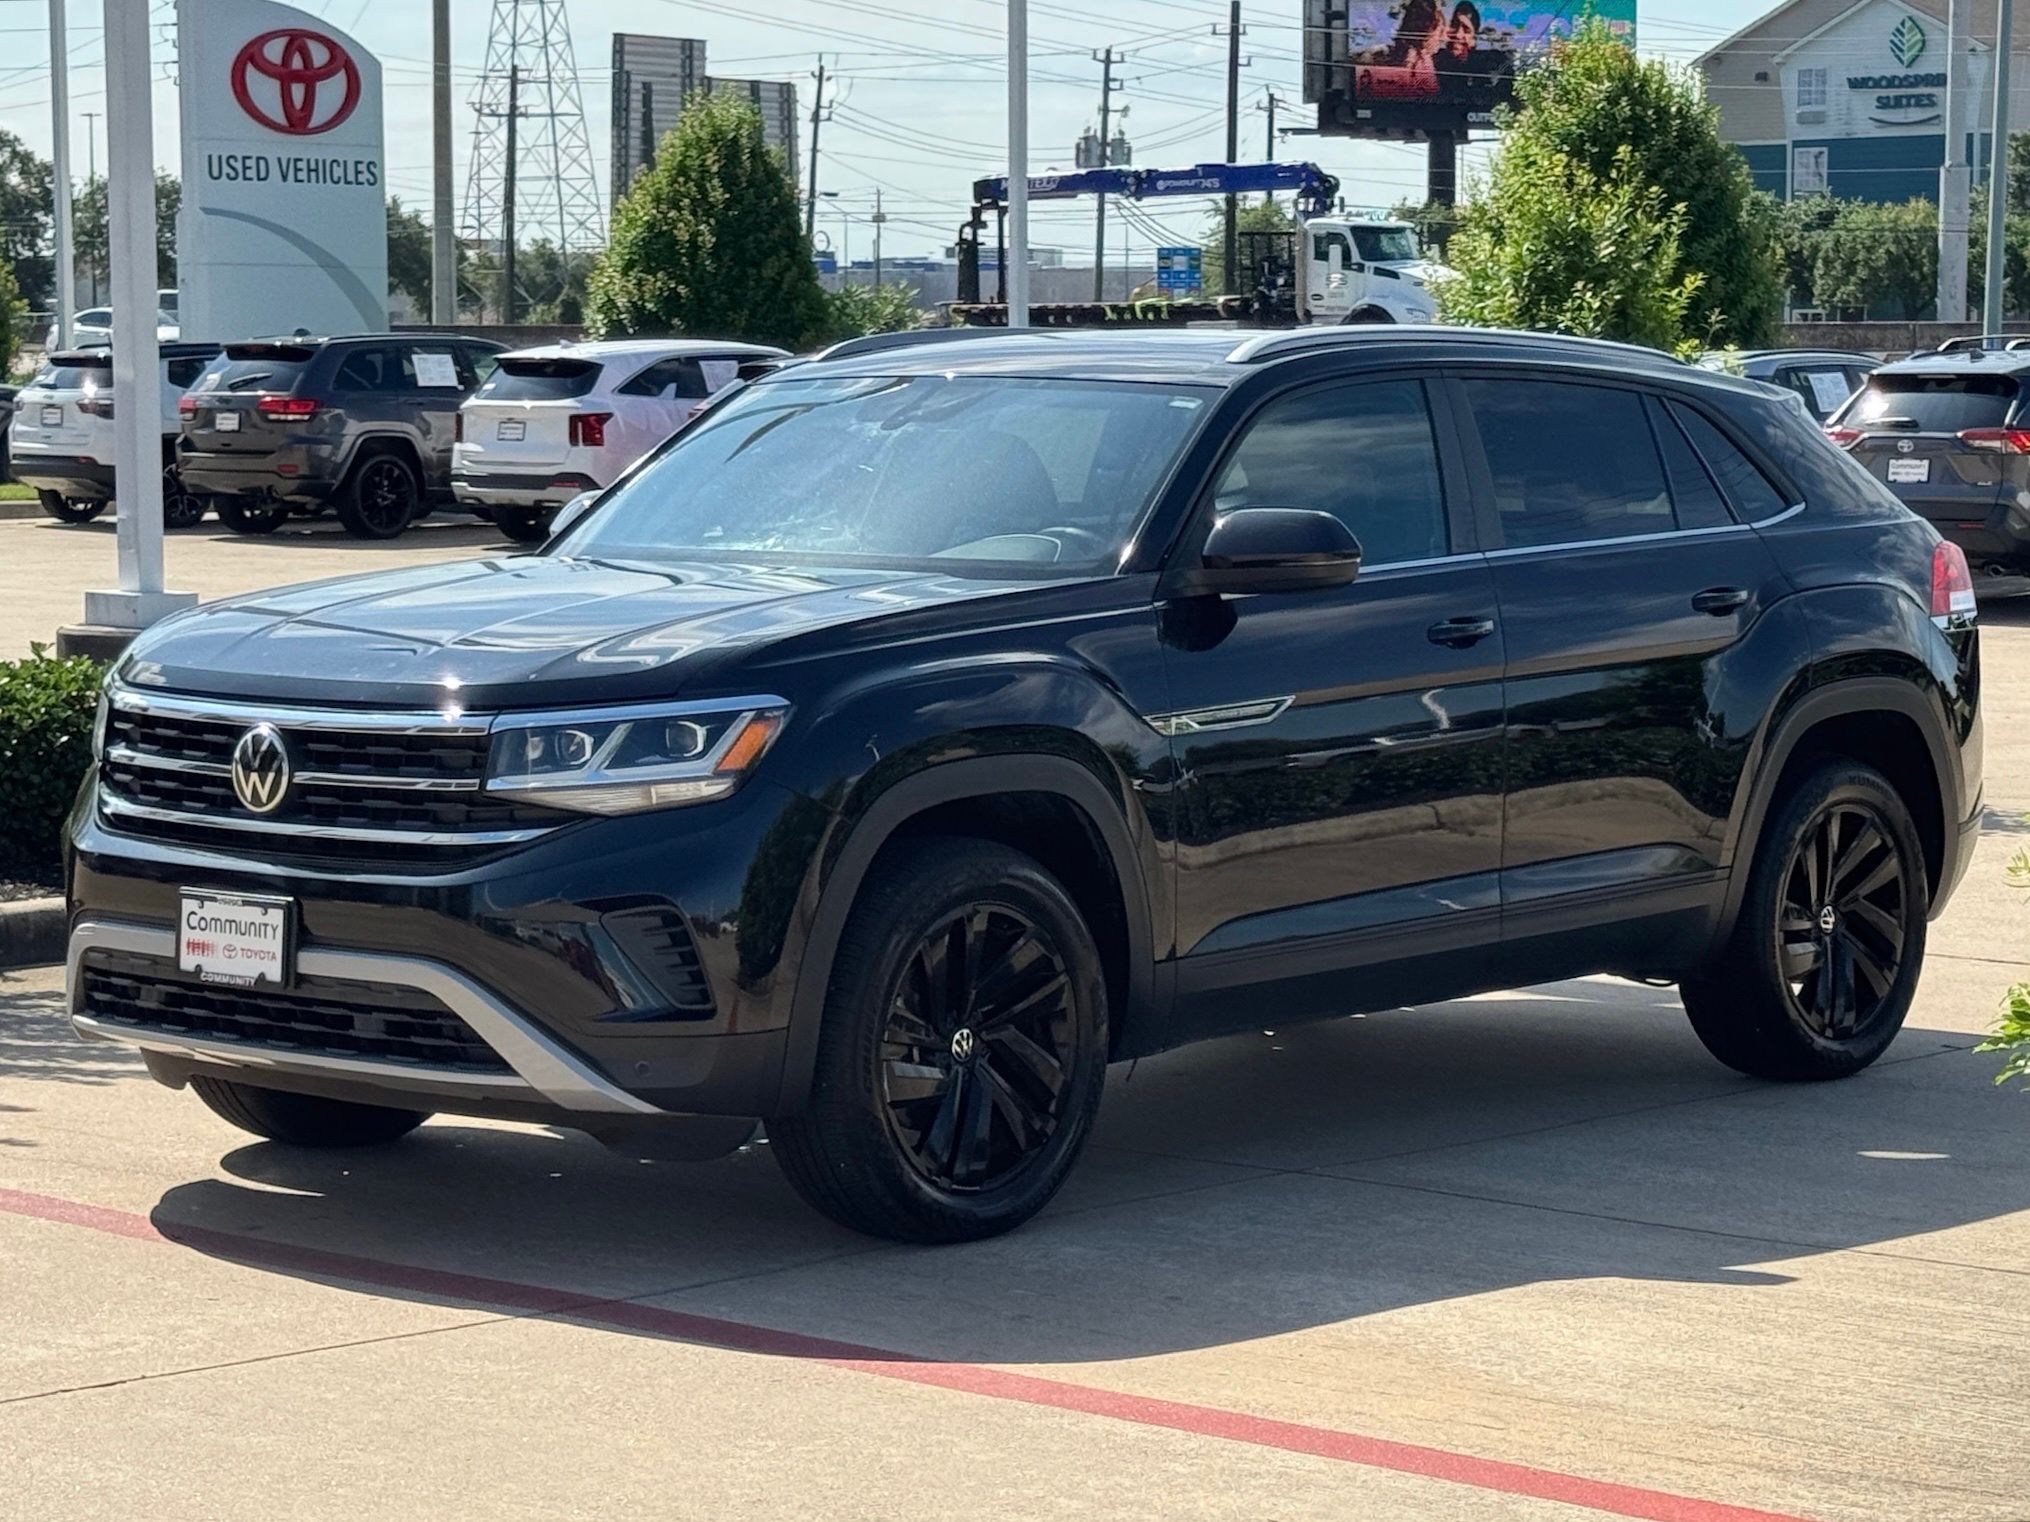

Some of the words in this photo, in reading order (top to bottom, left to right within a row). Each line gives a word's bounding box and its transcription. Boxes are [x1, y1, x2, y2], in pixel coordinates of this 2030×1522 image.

[1875, 94, 1937, 109] SUITES
[207, 154, 270, 182] USED
[277, 156, 379, 187] VEHICLES
[240, 947, 278, 962] TOYOTA
[201, 971, 257, 987] COMMUNITY
